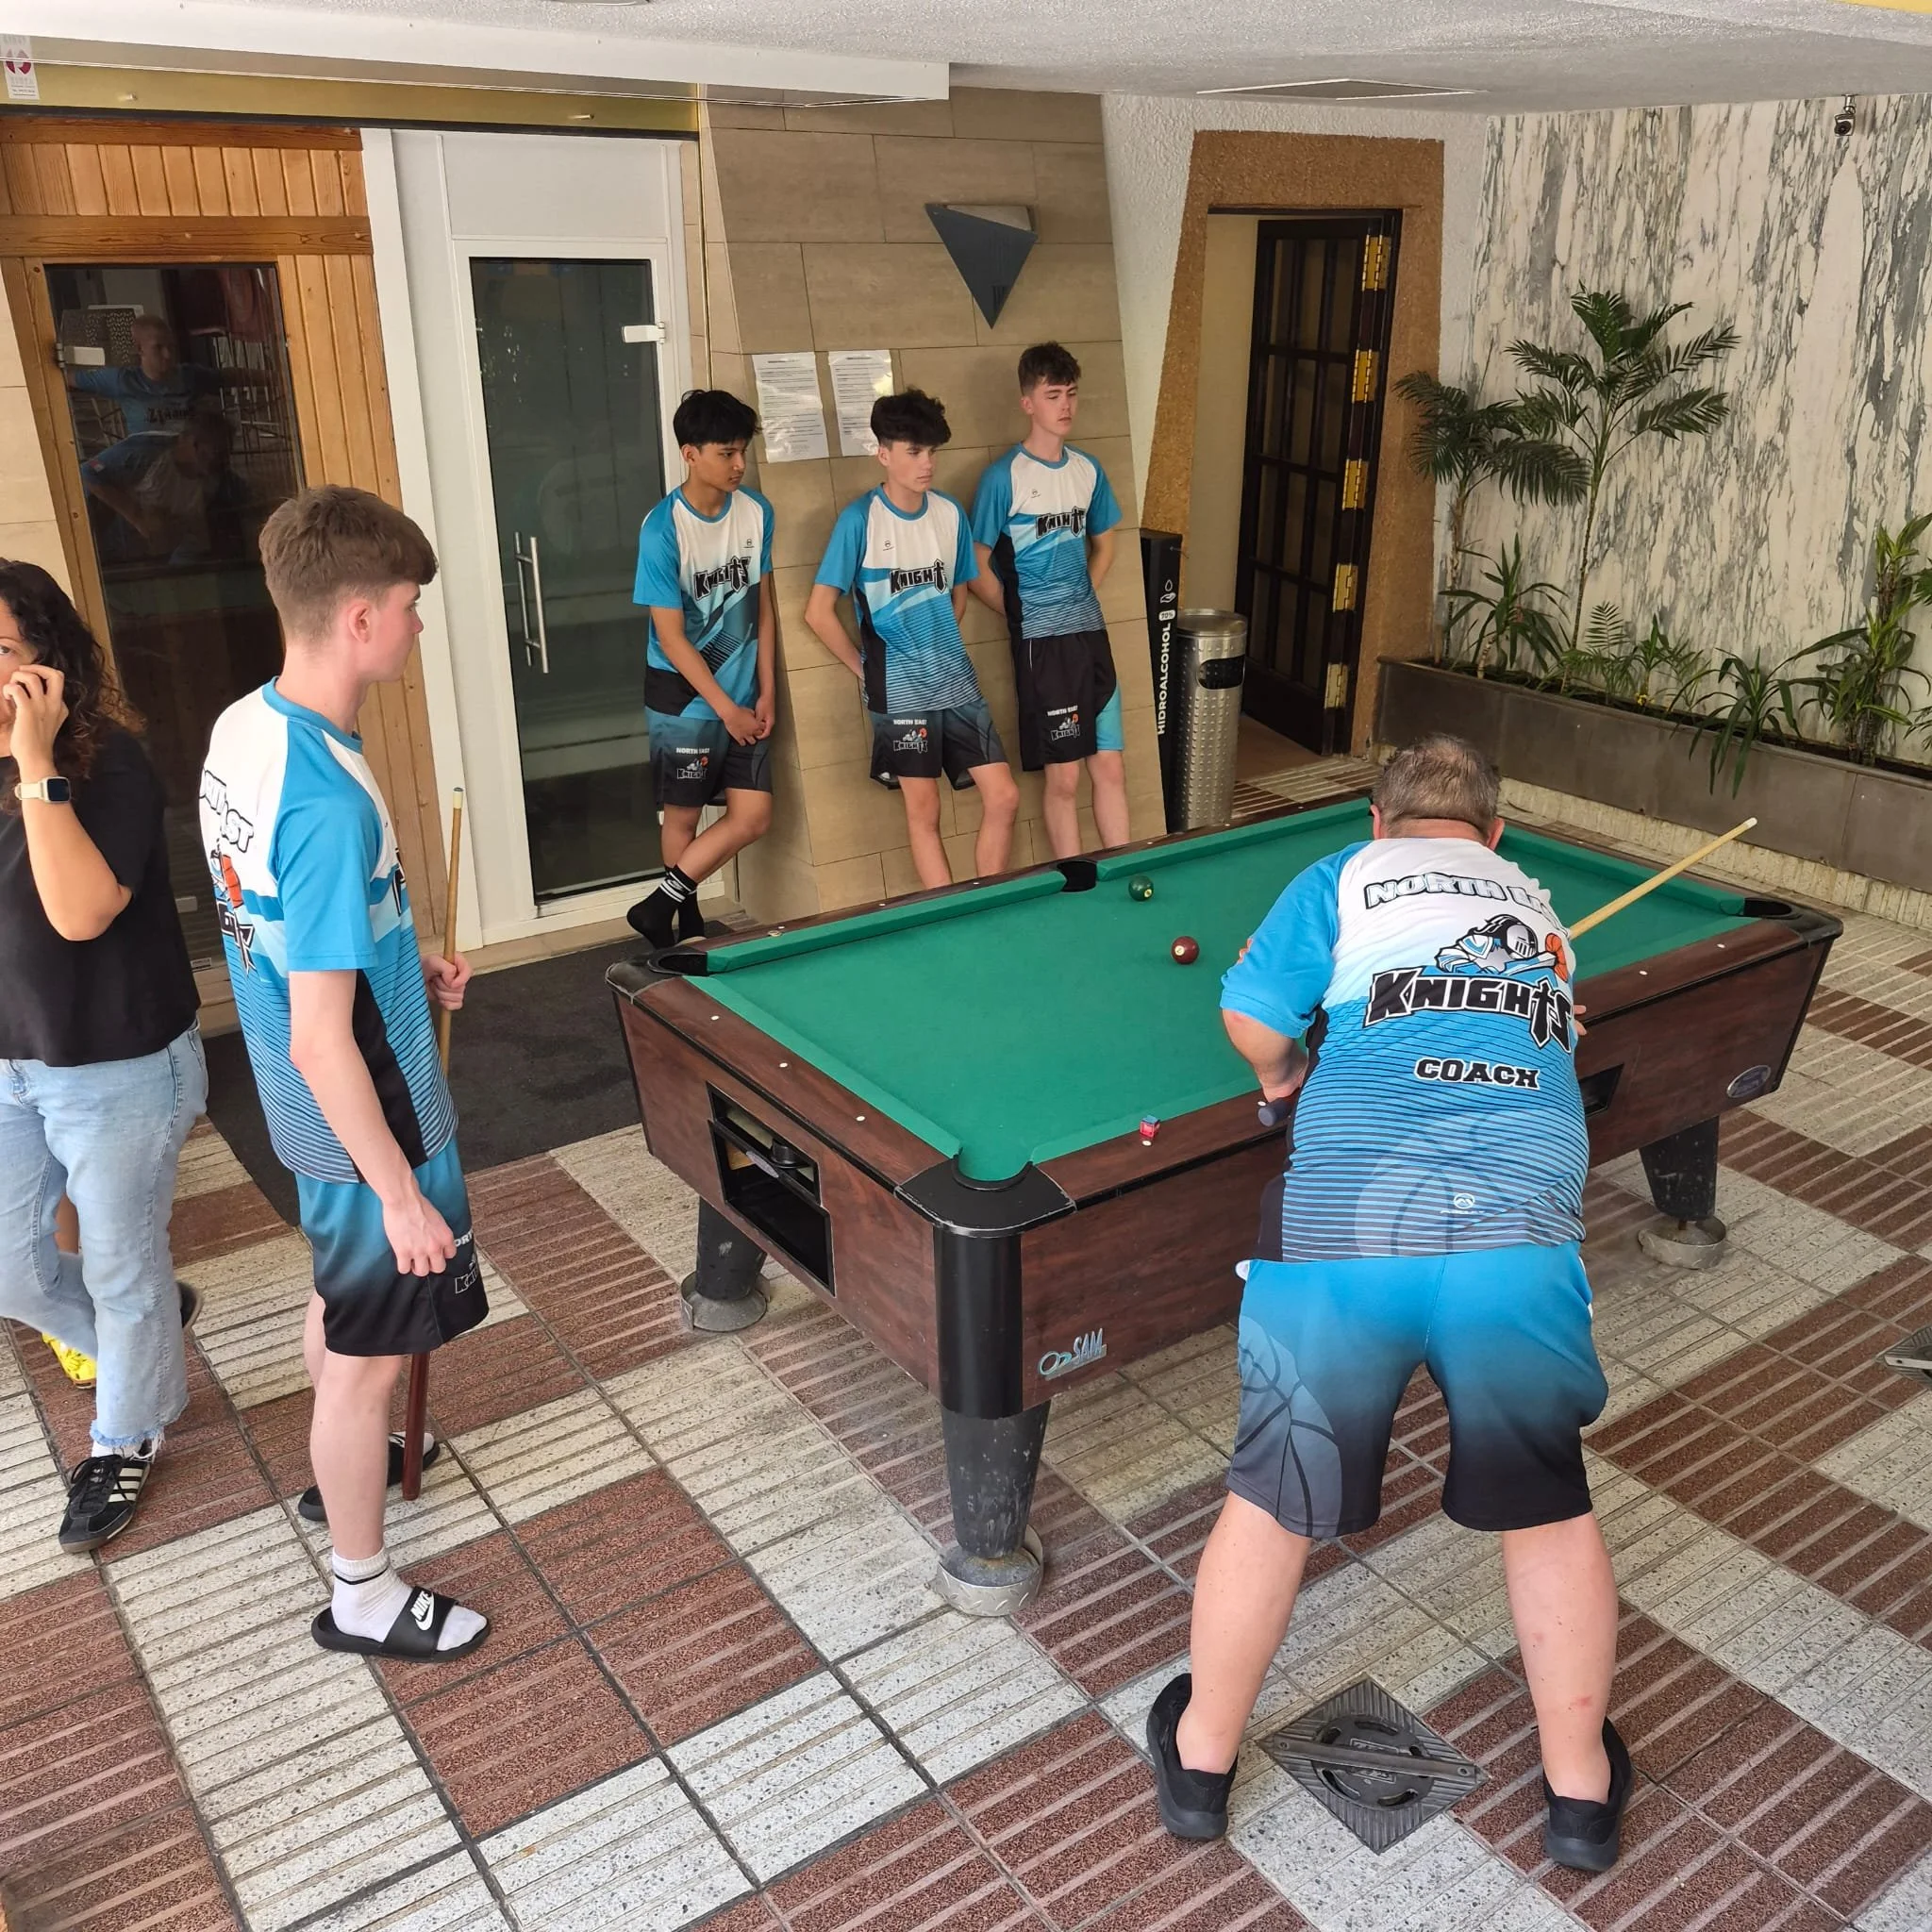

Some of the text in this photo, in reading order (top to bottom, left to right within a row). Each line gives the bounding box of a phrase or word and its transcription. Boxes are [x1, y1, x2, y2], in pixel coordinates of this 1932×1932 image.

[890, 558, 947, 594] KNIGHT
[1158, 623, 1172, 736] HIDROALCOHOL
[1365, 872, 1507, 909] NORTH
[1363, 965, 1573, 1054] KNIGHTS
[1414, 1057, 1541, 1091] COACH
